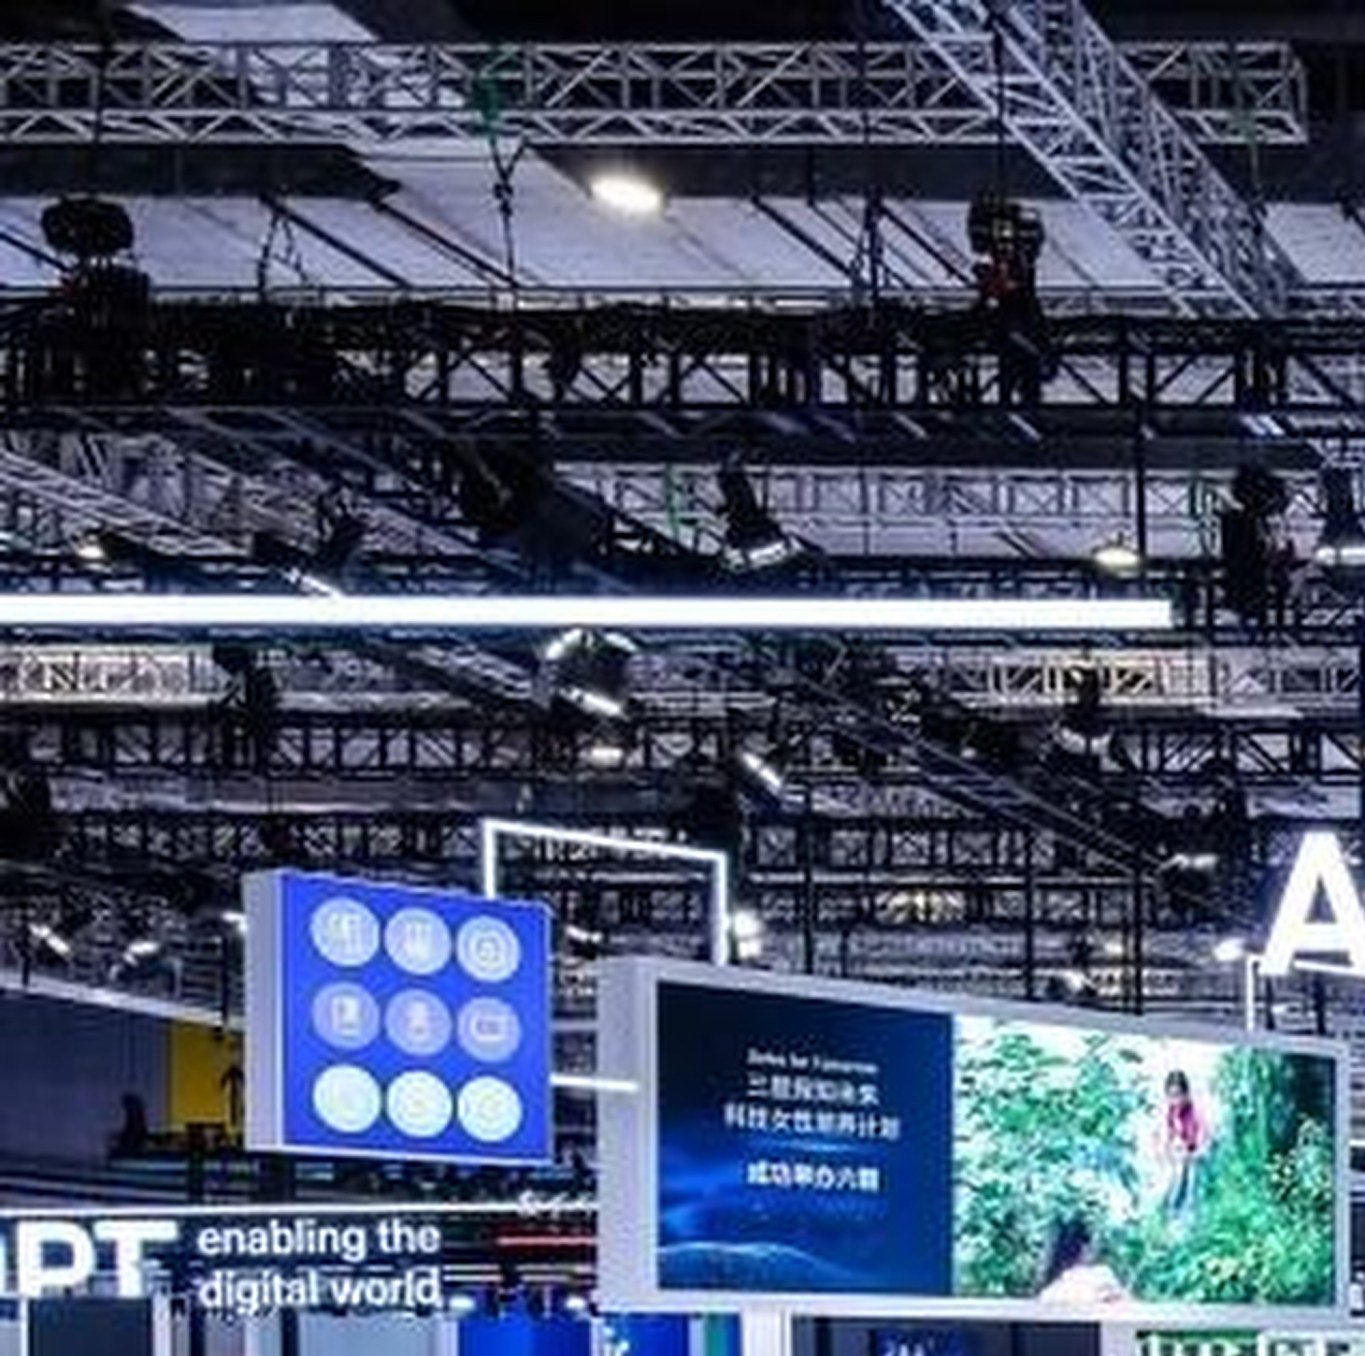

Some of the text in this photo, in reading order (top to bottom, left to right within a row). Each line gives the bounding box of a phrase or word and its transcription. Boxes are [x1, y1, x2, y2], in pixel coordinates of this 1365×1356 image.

[197, 1217, 442, 1262] enabling the
[198, 1267, 441, 1315] digital world
